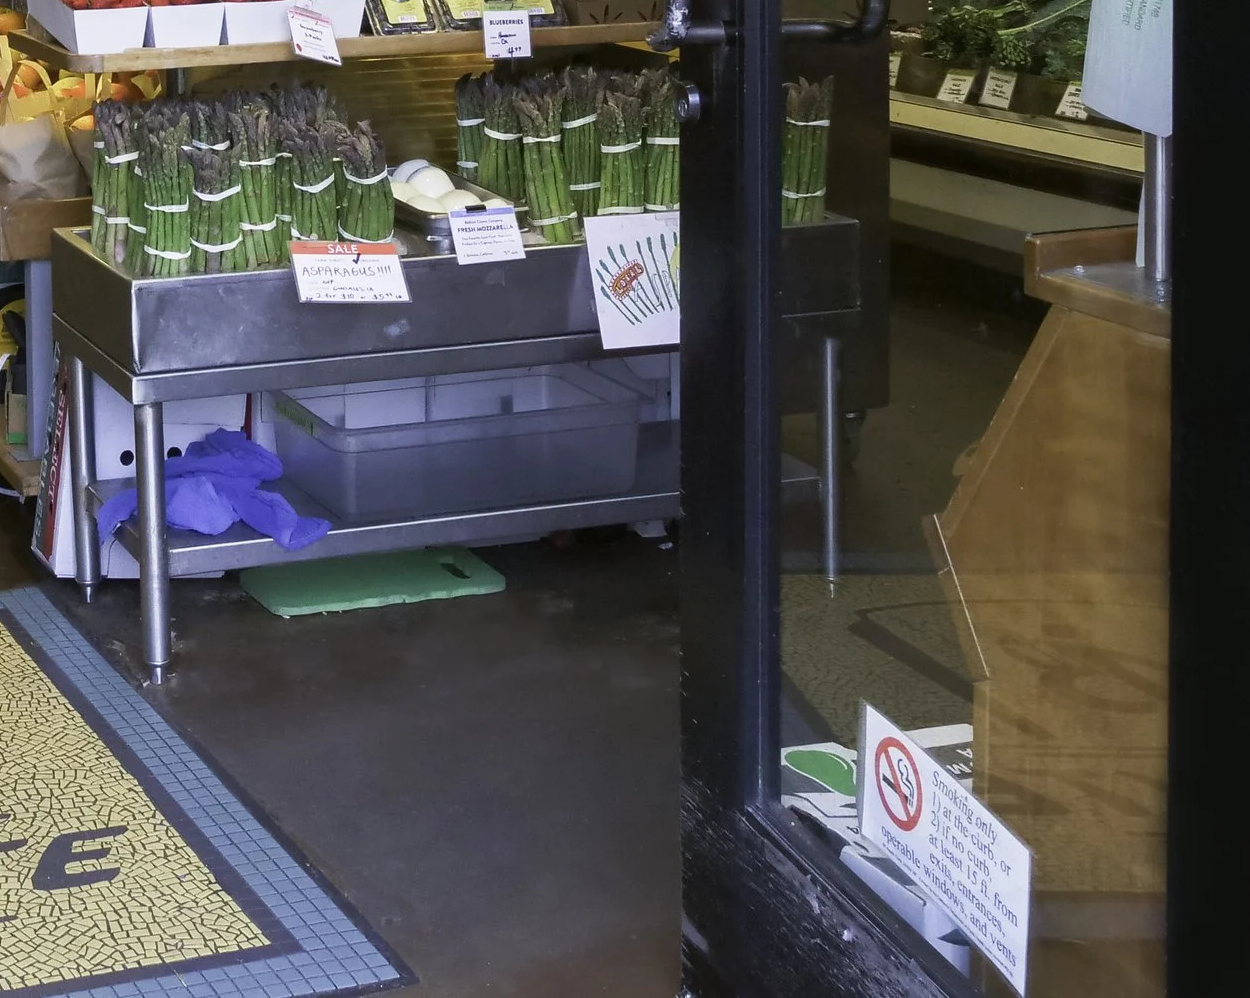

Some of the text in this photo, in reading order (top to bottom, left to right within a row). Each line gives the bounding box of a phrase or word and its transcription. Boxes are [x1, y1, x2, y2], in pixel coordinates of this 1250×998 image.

[489, 18, 524, 26] BLUEBERRIES
[327, 244, 359, 254] SALE
[477, 224, 514, 232] MOZZARELLA
[48, 389, 66, 507] SELECT
[930, 810, 993, 884] 2) if no curb,
[931, 770, 998, 846] Smoking only
[931, 791, 1011, 877] 1) at the curb, or
[881, 826, 1017, 968] operable windows, and vents
[928, 833, 1018, 927] at least 15 ft. from
[929, 852, 1006, 938] exits, entrances,
